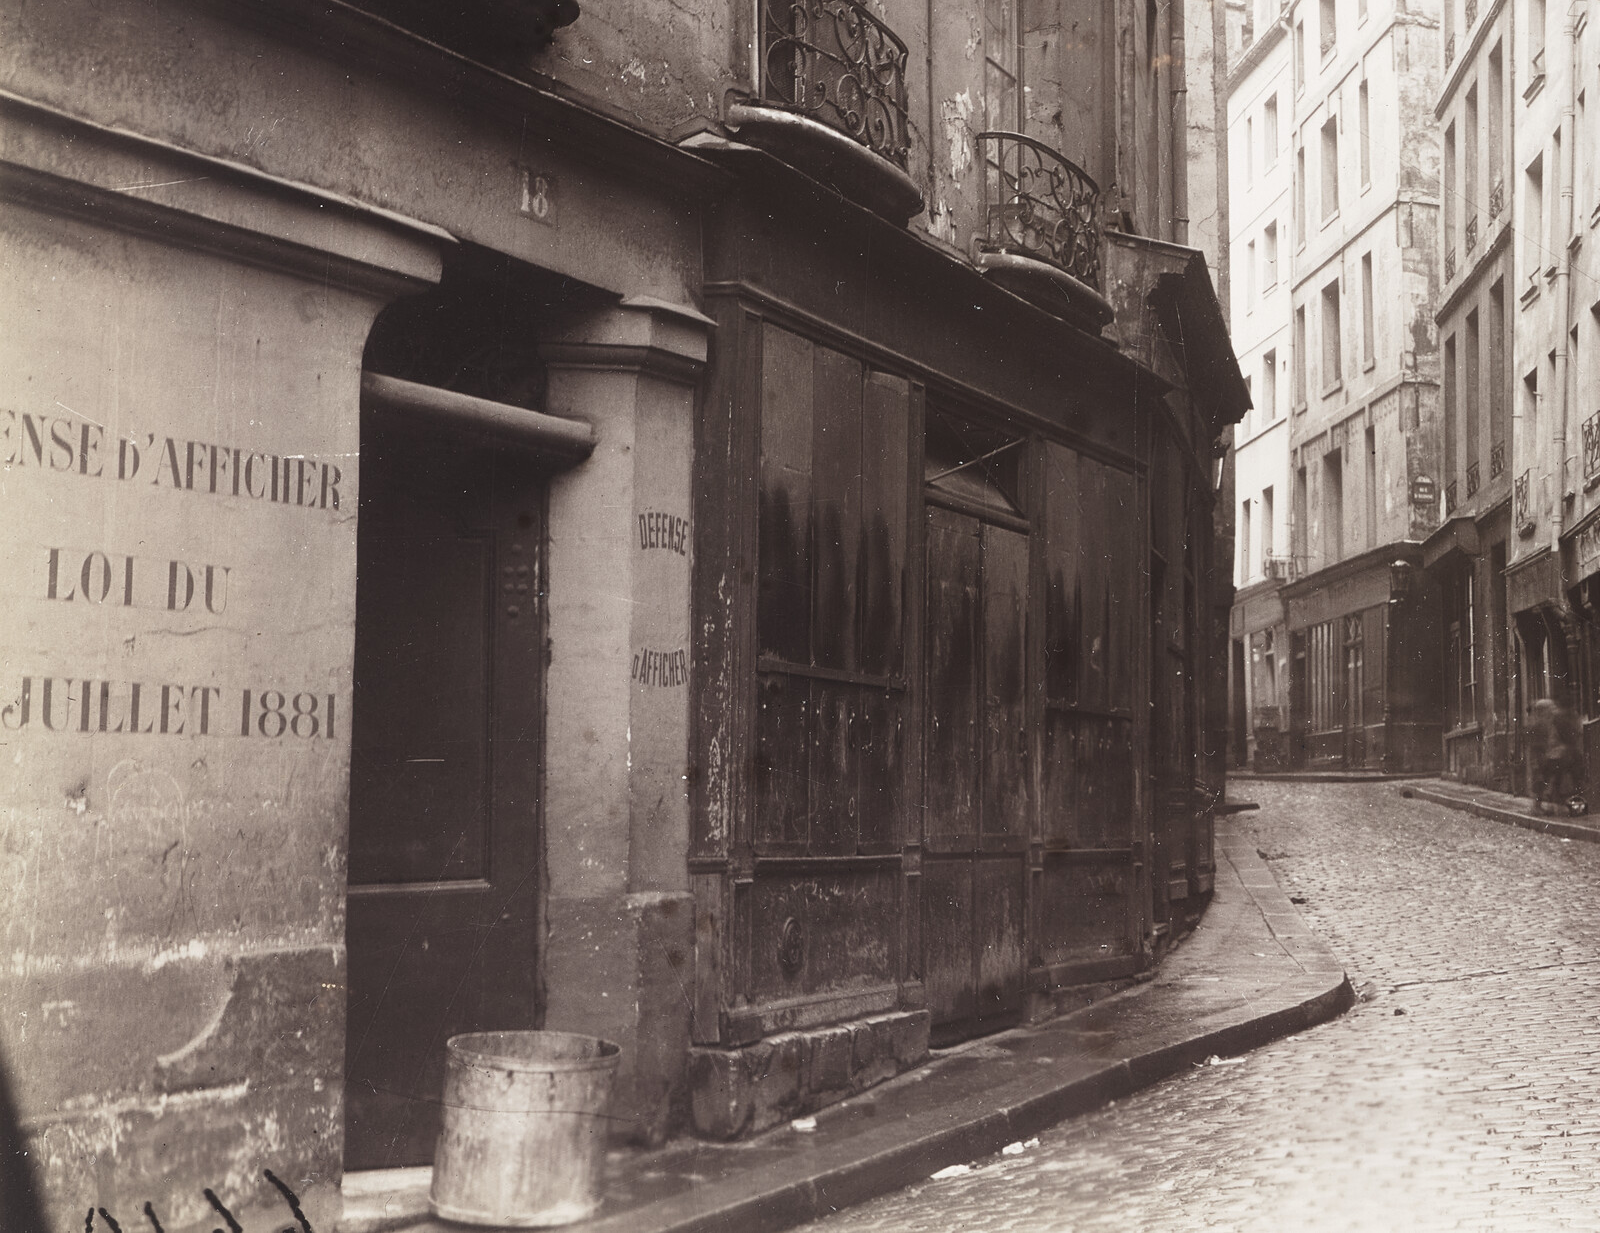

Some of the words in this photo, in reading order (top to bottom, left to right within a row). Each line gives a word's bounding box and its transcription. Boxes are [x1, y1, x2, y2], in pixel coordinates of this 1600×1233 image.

[520, 170, 548, 218] 18
[118, 432, 342, 512] D'AFFICHER
[47, 548, 135, 607] LOI
[167, 560, 232, 615] DU
[1, 676, 221, 736] JUILLET
[240, 688, 337, 740] 1881
